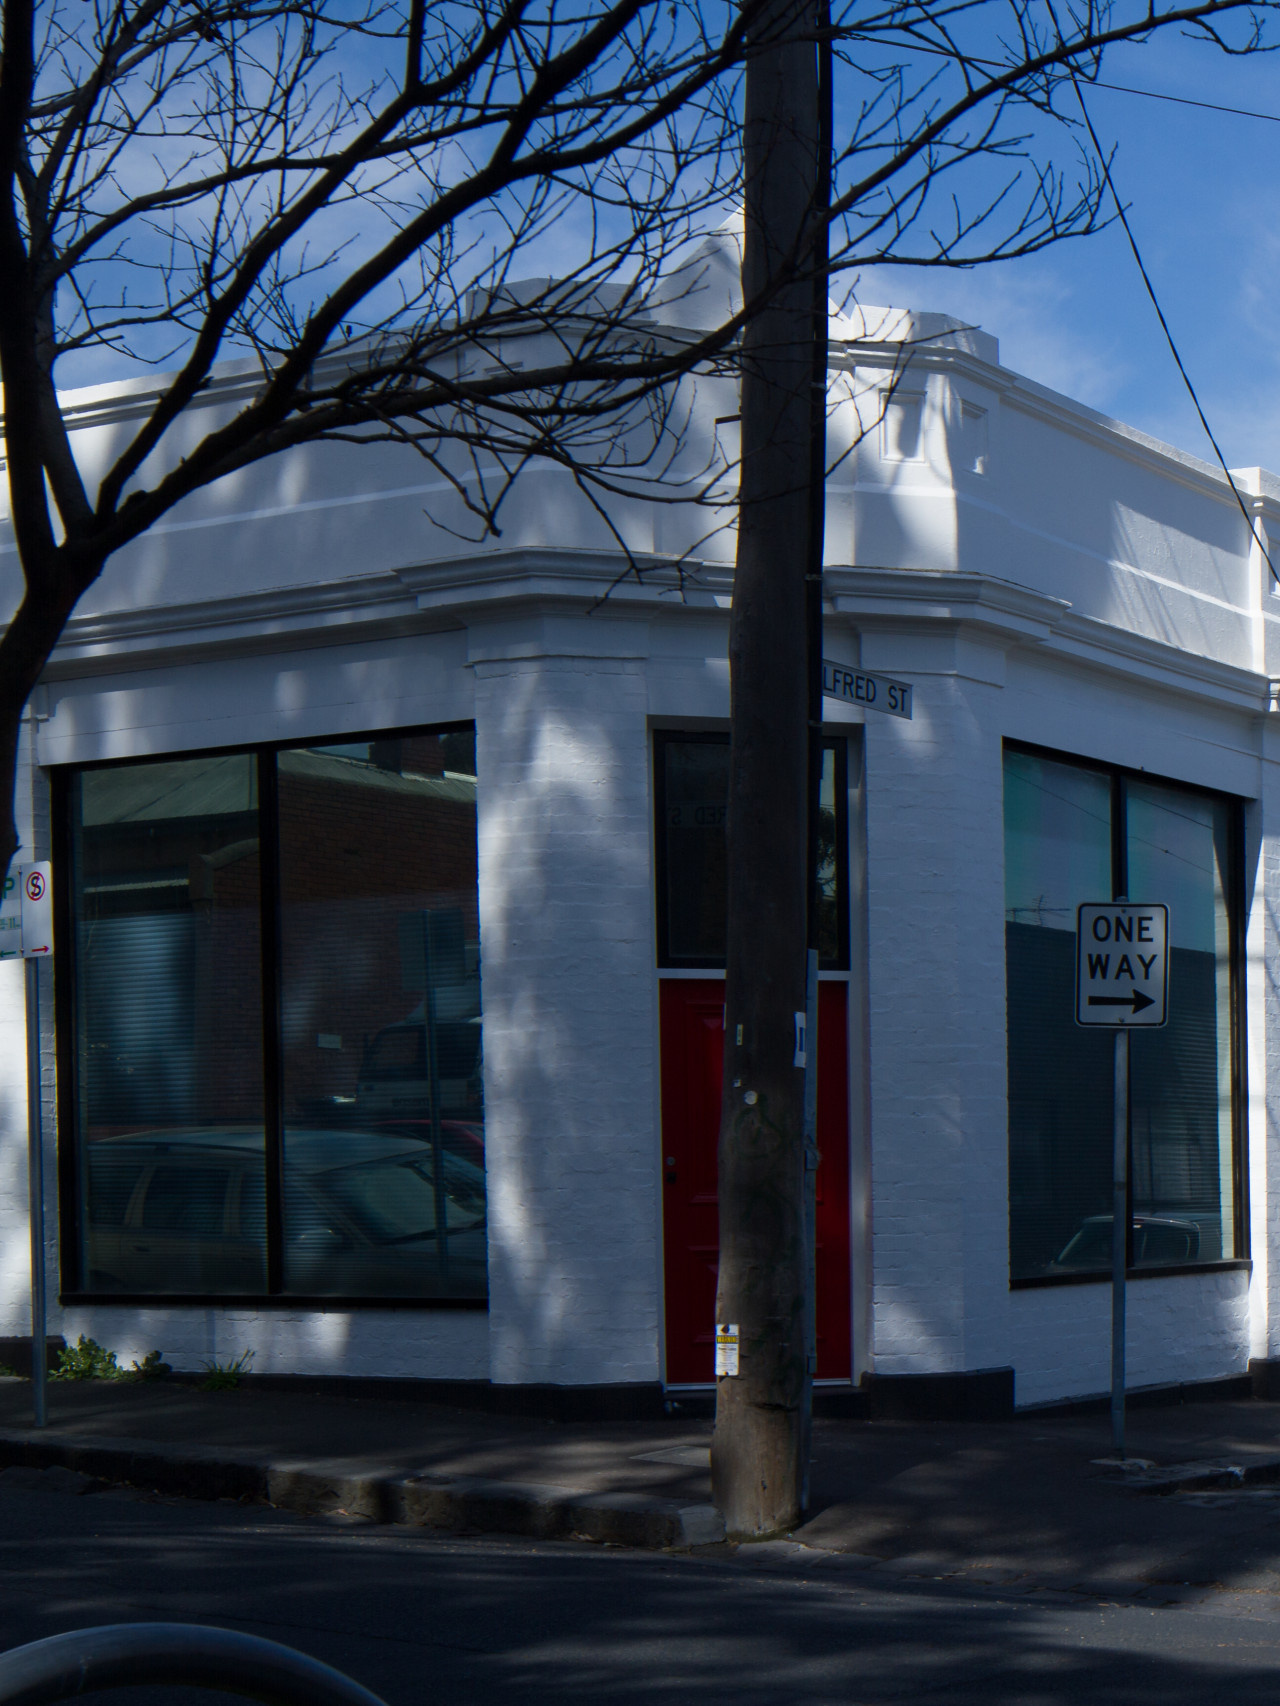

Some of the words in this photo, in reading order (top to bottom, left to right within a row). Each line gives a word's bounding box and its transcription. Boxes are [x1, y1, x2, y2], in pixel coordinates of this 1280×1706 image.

[823, 666, 876, 703] LFRED
[888, 685, 907, 711] ST
[1092, 915, 1154, 942] ONE
[1087, 953, 1158, 980] WAY
